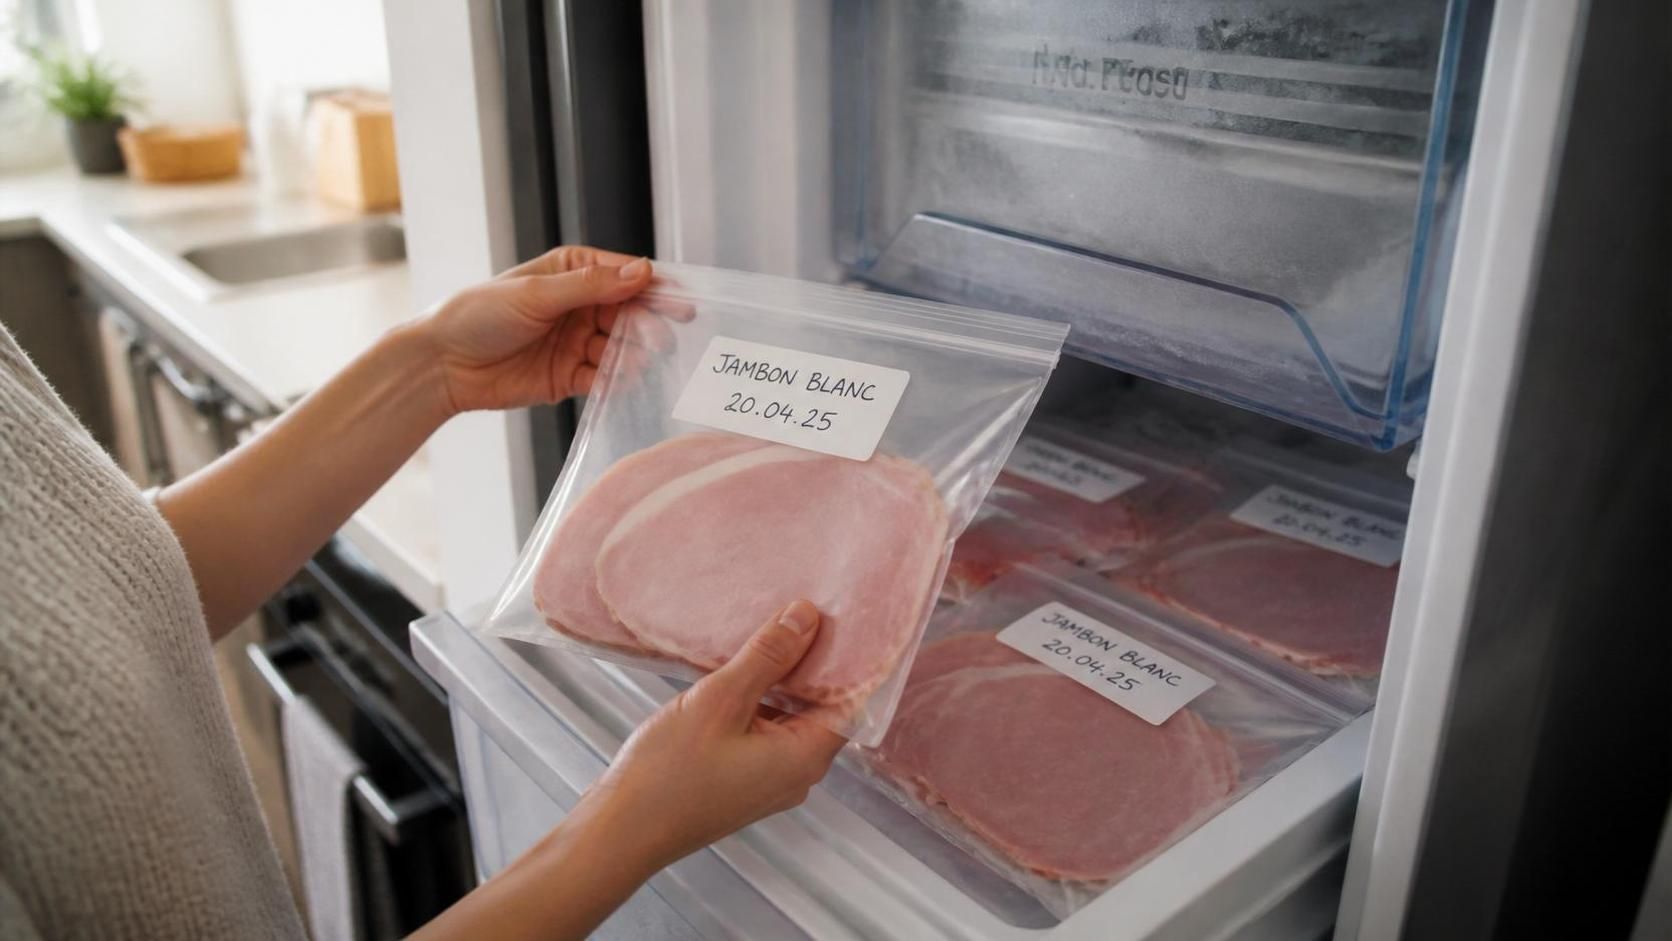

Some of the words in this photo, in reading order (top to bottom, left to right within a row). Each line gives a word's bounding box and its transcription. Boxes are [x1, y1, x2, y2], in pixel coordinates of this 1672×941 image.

[712, 353, 798, 385] JAMBON
[806, 372, 877, 401] BLANC
[723, 392, 838, 431] 20.04.25
[1041, 612, 1118, 652] JAMBON
[1119, 650, 1183, 687] BLANC
[1042, 639, 1141, 691] 20.04.25
